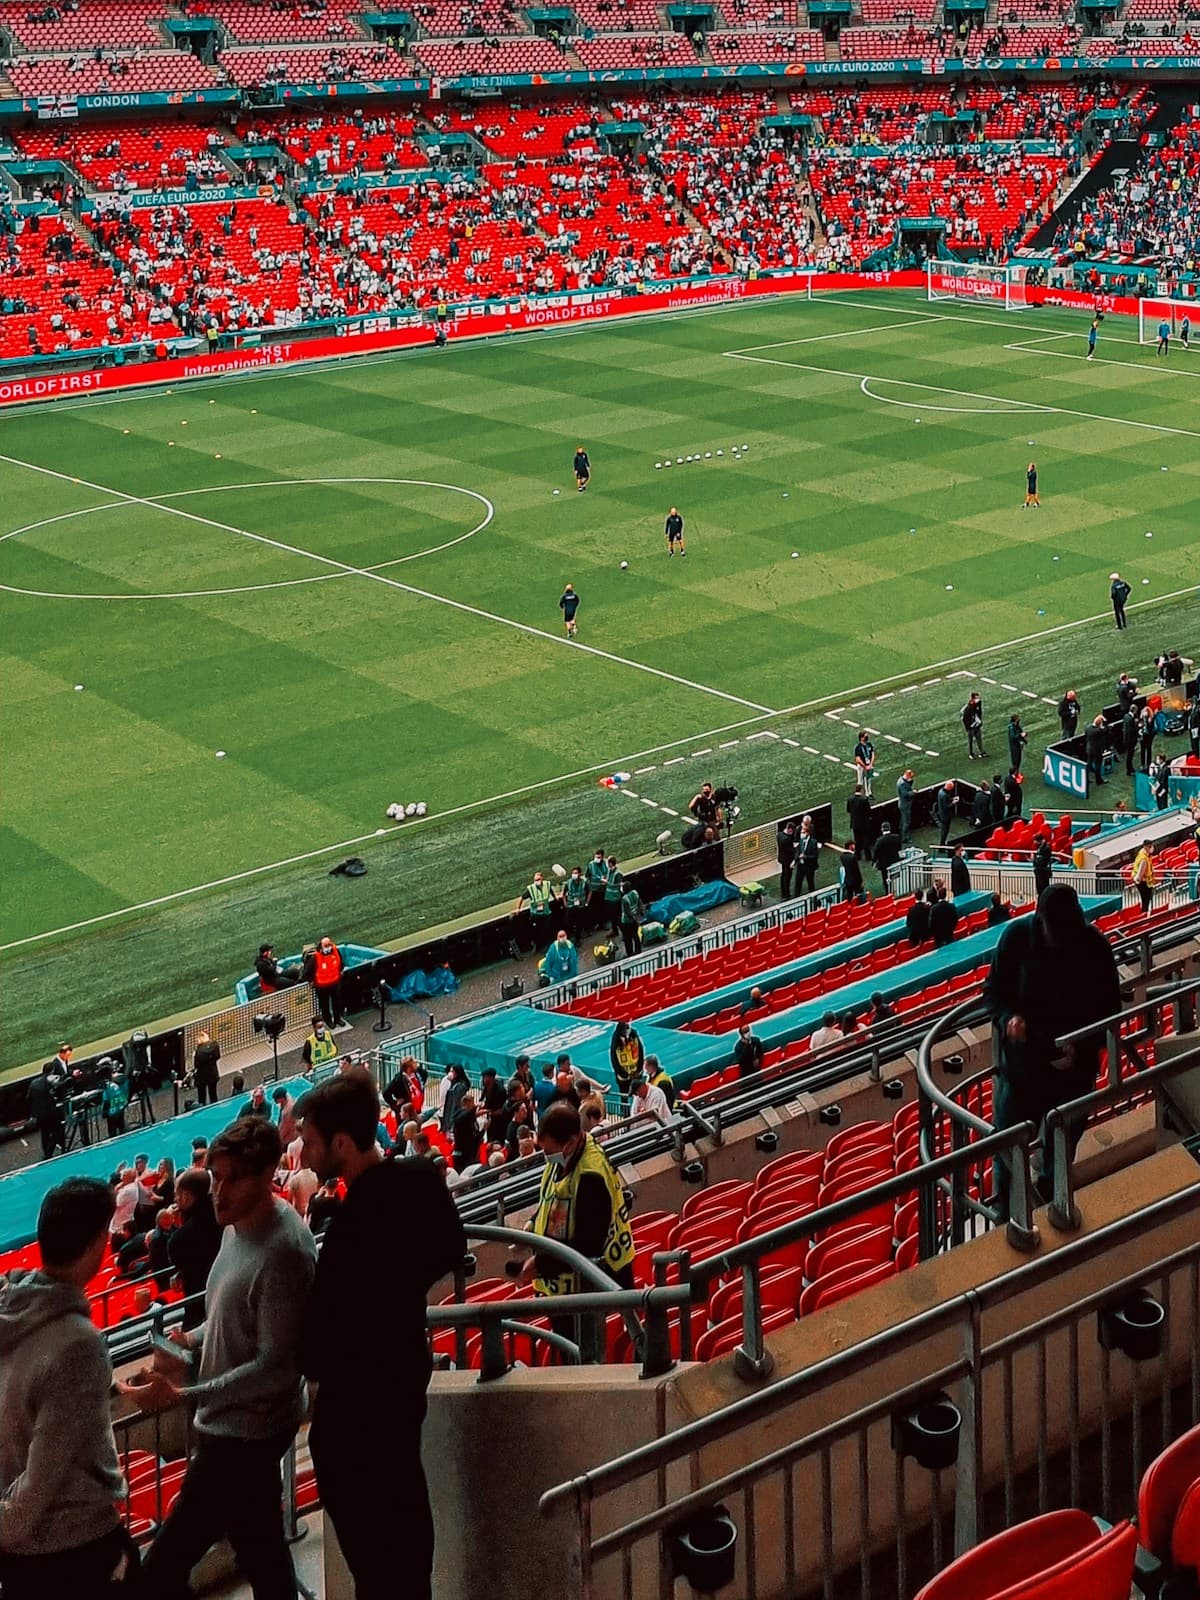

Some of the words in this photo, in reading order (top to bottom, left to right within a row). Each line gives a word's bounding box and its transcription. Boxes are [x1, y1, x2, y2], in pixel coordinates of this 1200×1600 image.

[814, 63, 841, 73] UEFA
[842, 62, 869, 72] EURO
[870, 61, 895, 72] 2020
[86, 94, 140, 108] LONDON
[136, 194, 167, 206] UEFA
[167, 192, 197, 204] EURO
[199, 189, 226, 201] 2020
[524, 302, 611, 325] WORLDFIRST
[1058, 760, 1087, 793] EU
